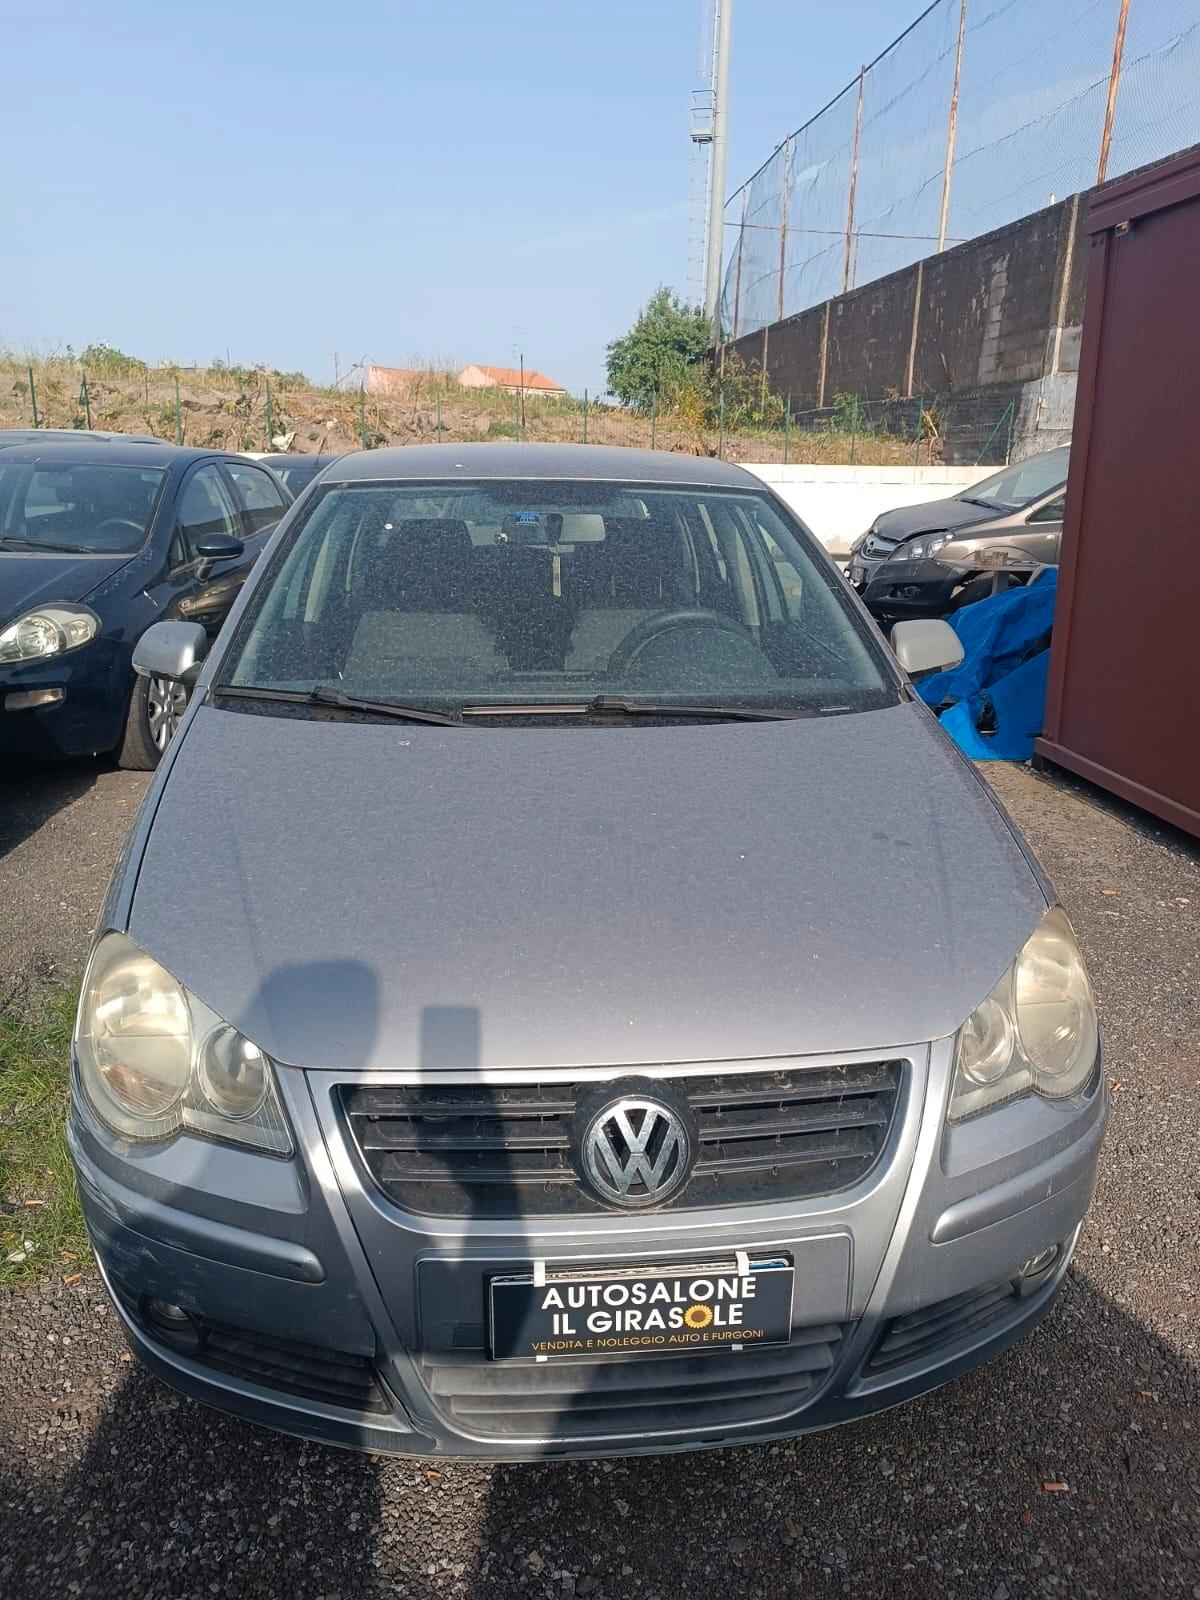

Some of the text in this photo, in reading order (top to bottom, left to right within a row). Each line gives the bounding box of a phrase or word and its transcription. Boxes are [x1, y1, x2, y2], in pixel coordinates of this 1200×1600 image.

[587, 1099, 685, 1201] VW
[541, 1276, 757, 1310] AUTOSALONE
[553, 1303, 744, 1335] IL GIRASOLE
[531, 1329, 764, 1351] VENDITA E NOLEGGIO AUTO E FURGONI
